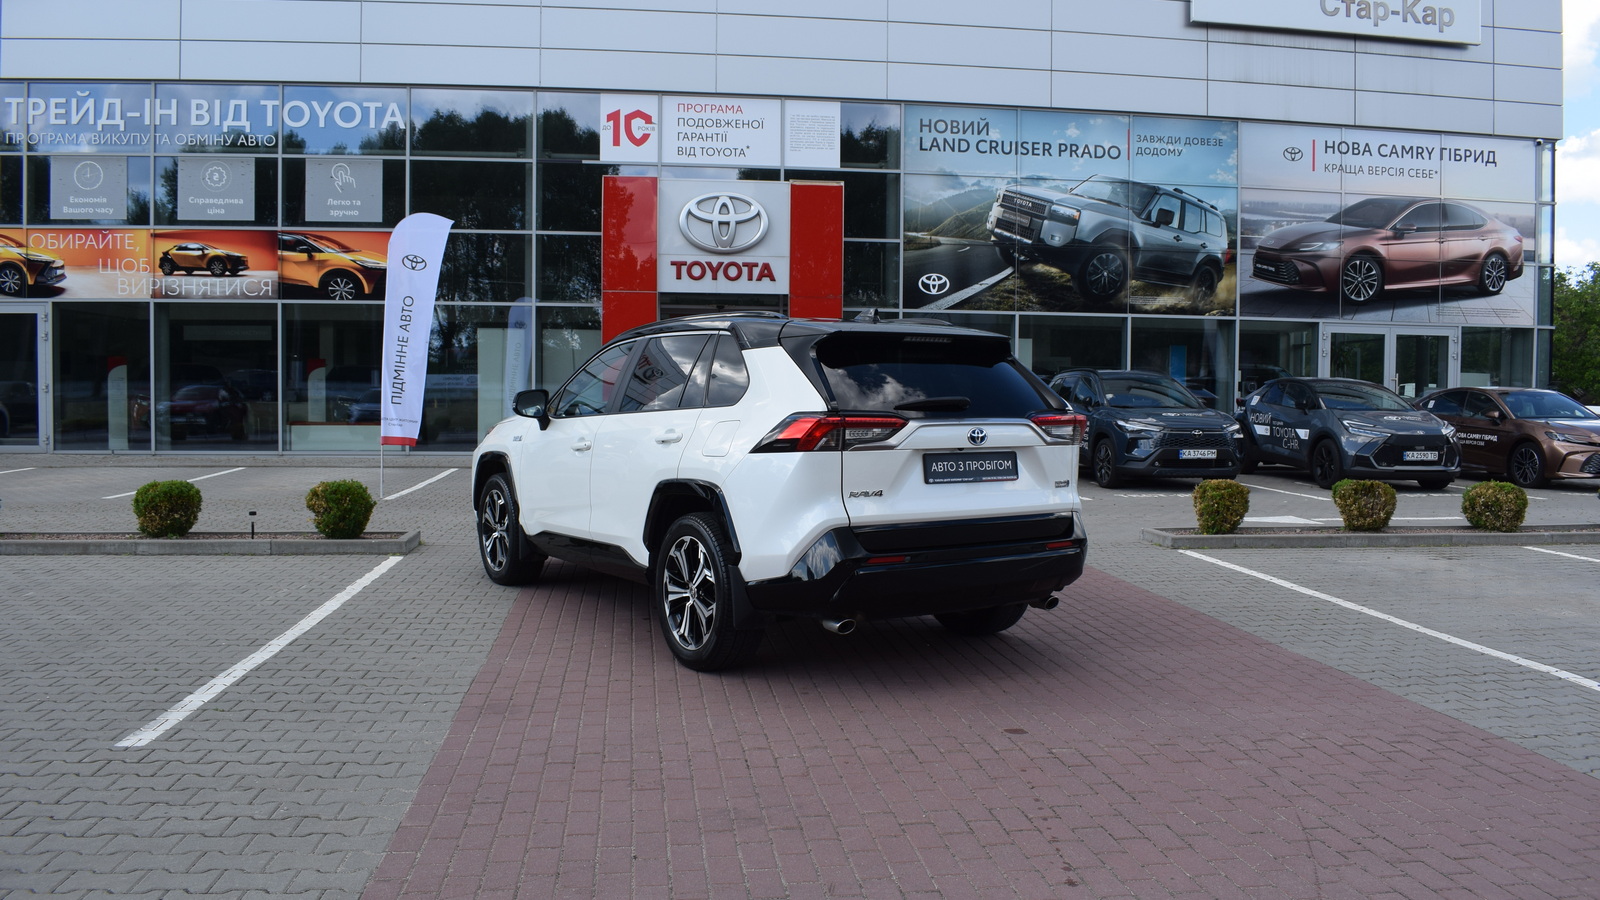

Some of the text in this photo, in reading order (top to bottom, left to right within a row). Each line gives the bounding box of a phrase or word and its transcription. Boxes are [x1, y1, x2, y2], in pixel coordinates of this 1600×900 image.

[1320, 0, 1456, 33] Стар-Кар
[5, 91, 406, 133] ТРЕЙД-ІН ВІД TOYOTA
[677, 103, 743, 115] ПРОГРАМА
[677, 117, 765, 130] ПОДОВЖЕНОЇ
[919, 117, 990, 136] НОВИЙ
[6, 132, 276, 147] ПРОГРАМА ВИКУПУ ТА ОБМІНУ АВТО
[677, 131, 728, 143] ГАРАНТІЇ
[1136, 134, 1224, 147] ЗАВЖДИ ДОВЕЗЕ
[677, 146, 697, 158] ВІД
[919, 137, 1122, 160] LAND CRUISER PRADO
[1136, 146, 1183, 157] ДОДОМУ
[1324, 140, 1498, 167] НОВА CAMRY ГІБРИД
[1324, 163, 1365, 176] КРАЩА
[1368, 166, 1405, 177] ВЕРСІЯ
[189, 196, 244, 205] Справедлива
[327, 198, 351, 206] Легко
[95, 207, 114, 215] часу
[207, 206, 225, 214] ціна
[29, 231, 141, 252] ОБИРАЙТЕ,
[100, 258, 151, 277] ЩОБ
[670, 260, 777, 282] TOYOTA
[118, 278, 273, 296] ВИРІЗНЯТИСЯ
[400, 296, 415, 333] АВТО
[391, 335, 410, 405] ПІДМІННЕ
[1250, 412, 1272, 424] НОВИЙ
[1273, 427, 1296, 438] TOYOTA
[1282, 438, 1300, 449] C-HR
[1415, 451, 1428, 459] 2590
[931, 461, 956, 472] АВТО
[965, 460, 1012, 471] ПРОБІГОМ
[848, 489, 884, 499] RAV4
